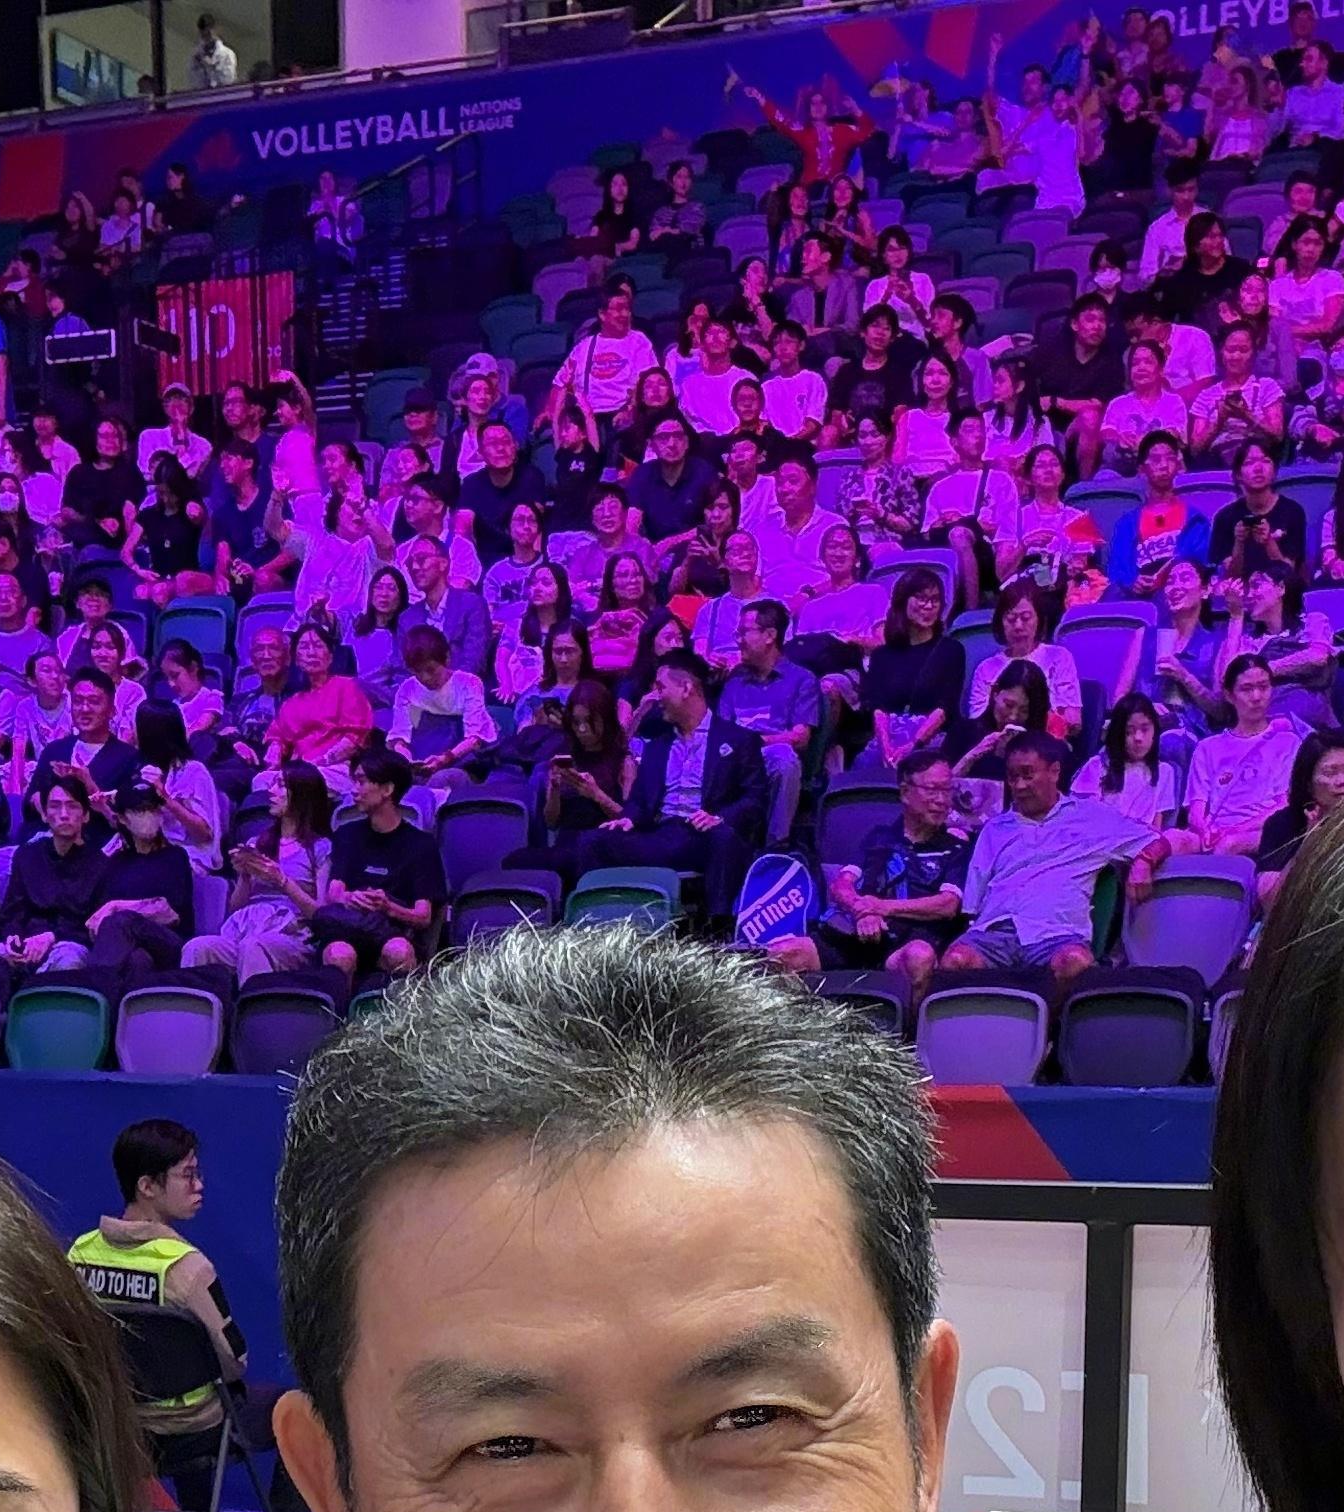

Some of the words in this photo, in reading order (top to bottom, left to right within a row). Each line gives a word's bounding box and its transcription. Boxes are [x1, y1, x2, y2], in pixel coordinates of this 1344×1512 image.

[459, 97, 522, 118] NATIONS
[251, 107, 455, 159] VOLLEYBALL
[460, 115, 514, 134] LEAGUE
[741, 888, 805, 945] prince
[107, 1271, 125, 1296] TO
[125, 1272, 157, 1300] HELP
